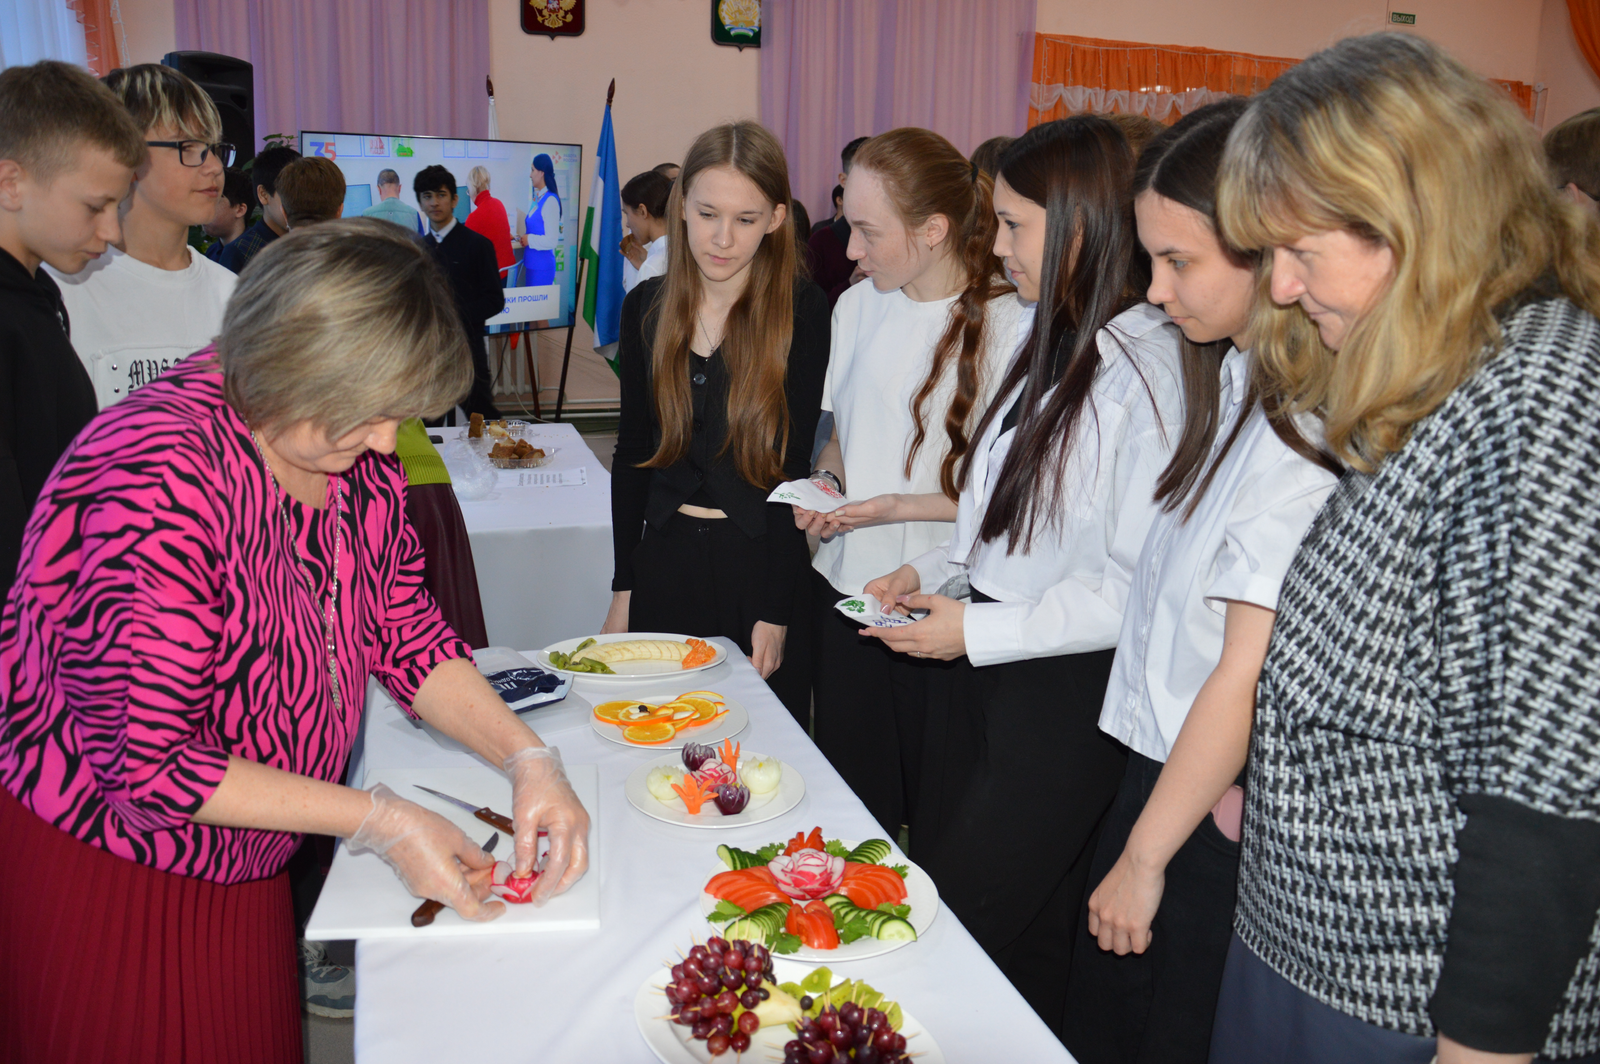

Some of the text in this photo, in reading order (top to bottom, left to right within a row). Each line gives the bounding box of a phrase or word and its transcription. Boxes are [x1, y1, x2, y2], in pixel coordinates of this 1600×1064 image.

[1392, 13, 1414, 24] ВЫХОД
[309, 141, 337, 162] 35
[517, 294, 549, 303] ПРОШЛИ
